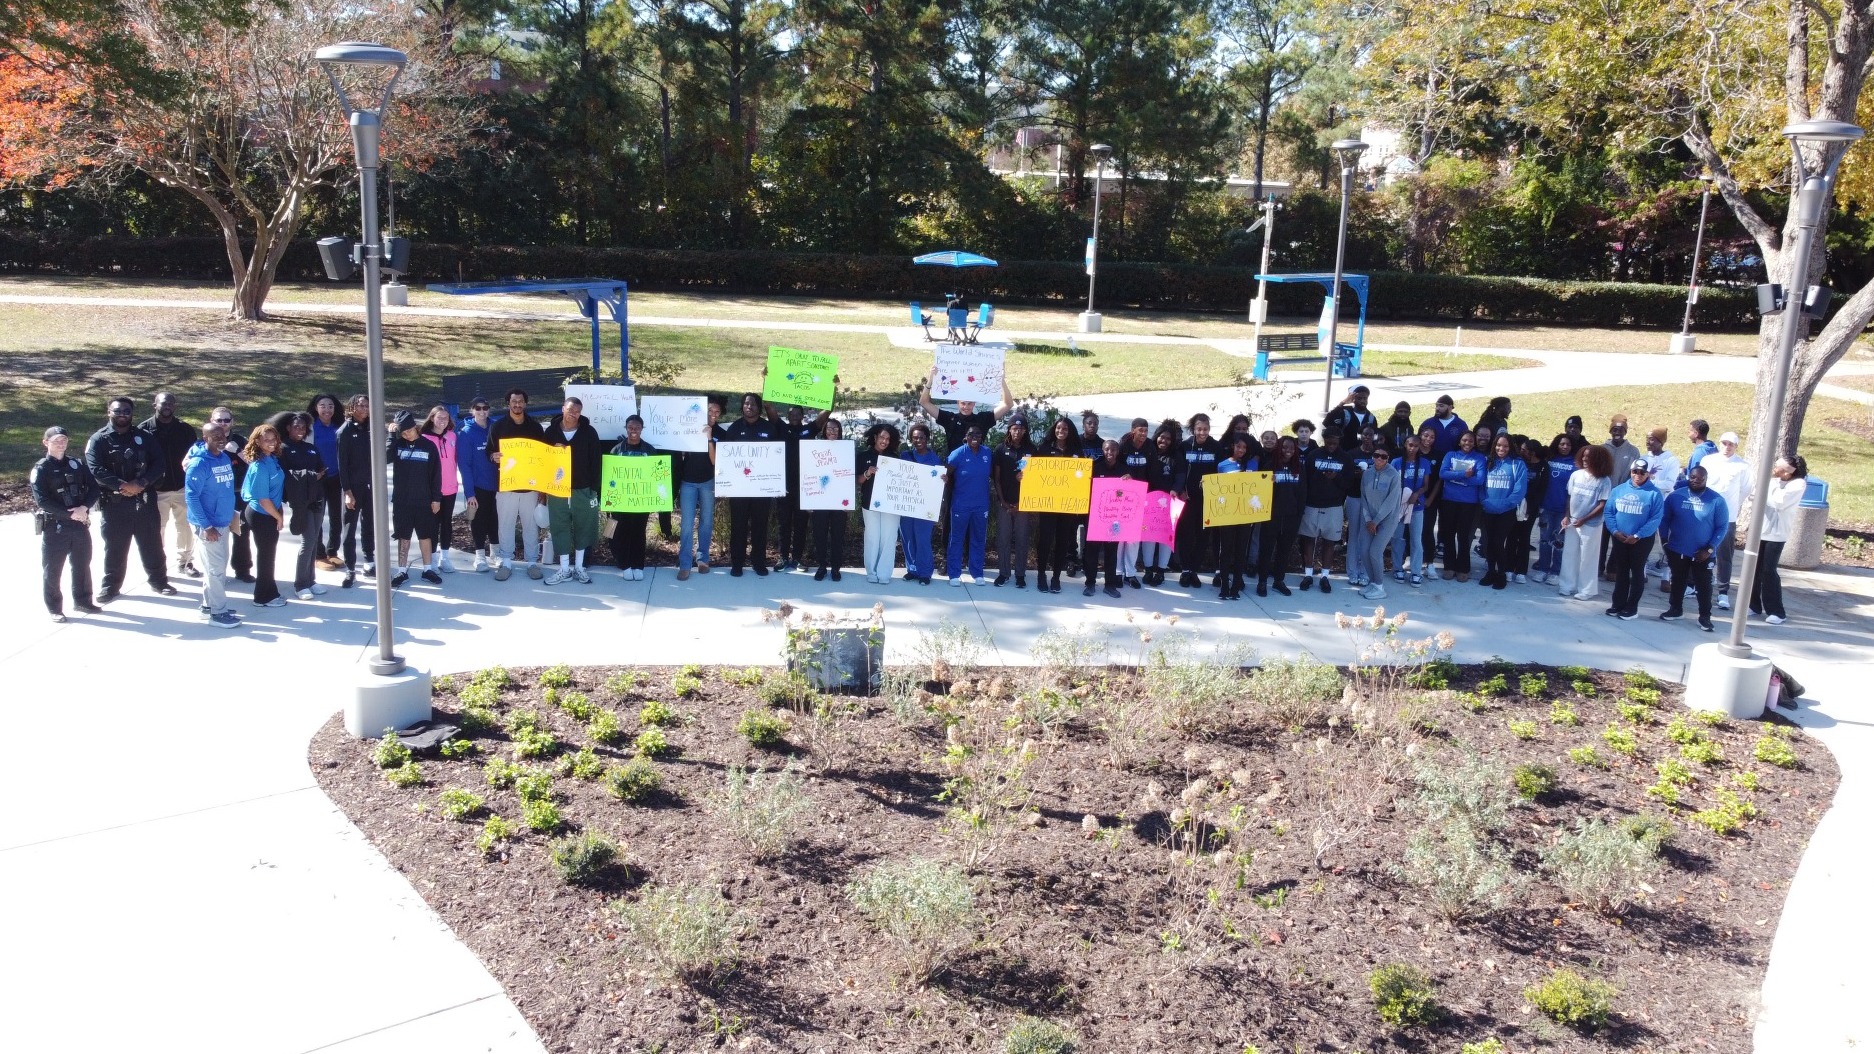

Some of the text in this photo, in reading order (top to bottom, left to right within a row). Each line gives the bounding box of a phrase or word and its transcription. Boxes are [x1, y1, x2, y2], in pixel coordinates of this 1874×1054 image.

[940, 346, 951, 355] The
[952, 346, 973, 356] World
[785, 358, 807, 368] APART
[771, 389, 781, 398] DO
[648, 403, 674, 425] You're
[652, 425, 669, 436] than
[502, 441, 534, 450] MENTAL
[721, 444, 770, 459] SAAC UNITY
[811, 449, 833, 460] Break
[733, 460, 755, 469] WALK
[899, 462, 915, 474] YOUR
[1030, 458, 1092, 472] PRIORITIZING
[214, 472, 234, 484] TRAC
[611, 466, 643, 480] MENTAL
[500, 477, 517, 488] FOR
[890, 478, 920, 489] IS JUST AS
[1039, 474, 1070, 489] YOUR
[621, 481, 652, 496] HEALTH
[886, 484, 923, 497] IMPORTANT AS
[590, 498, 599, 509] 93
[627, 496, 666, 507] MATTERS
[886, 492, 926, 506] YOUR PHYSICAL
[1020, 496, 1090, 512] MENTAL HEALTH
[893, 503, 916, 513] HEALTH
[1208, 498, 1231, 518] Not
